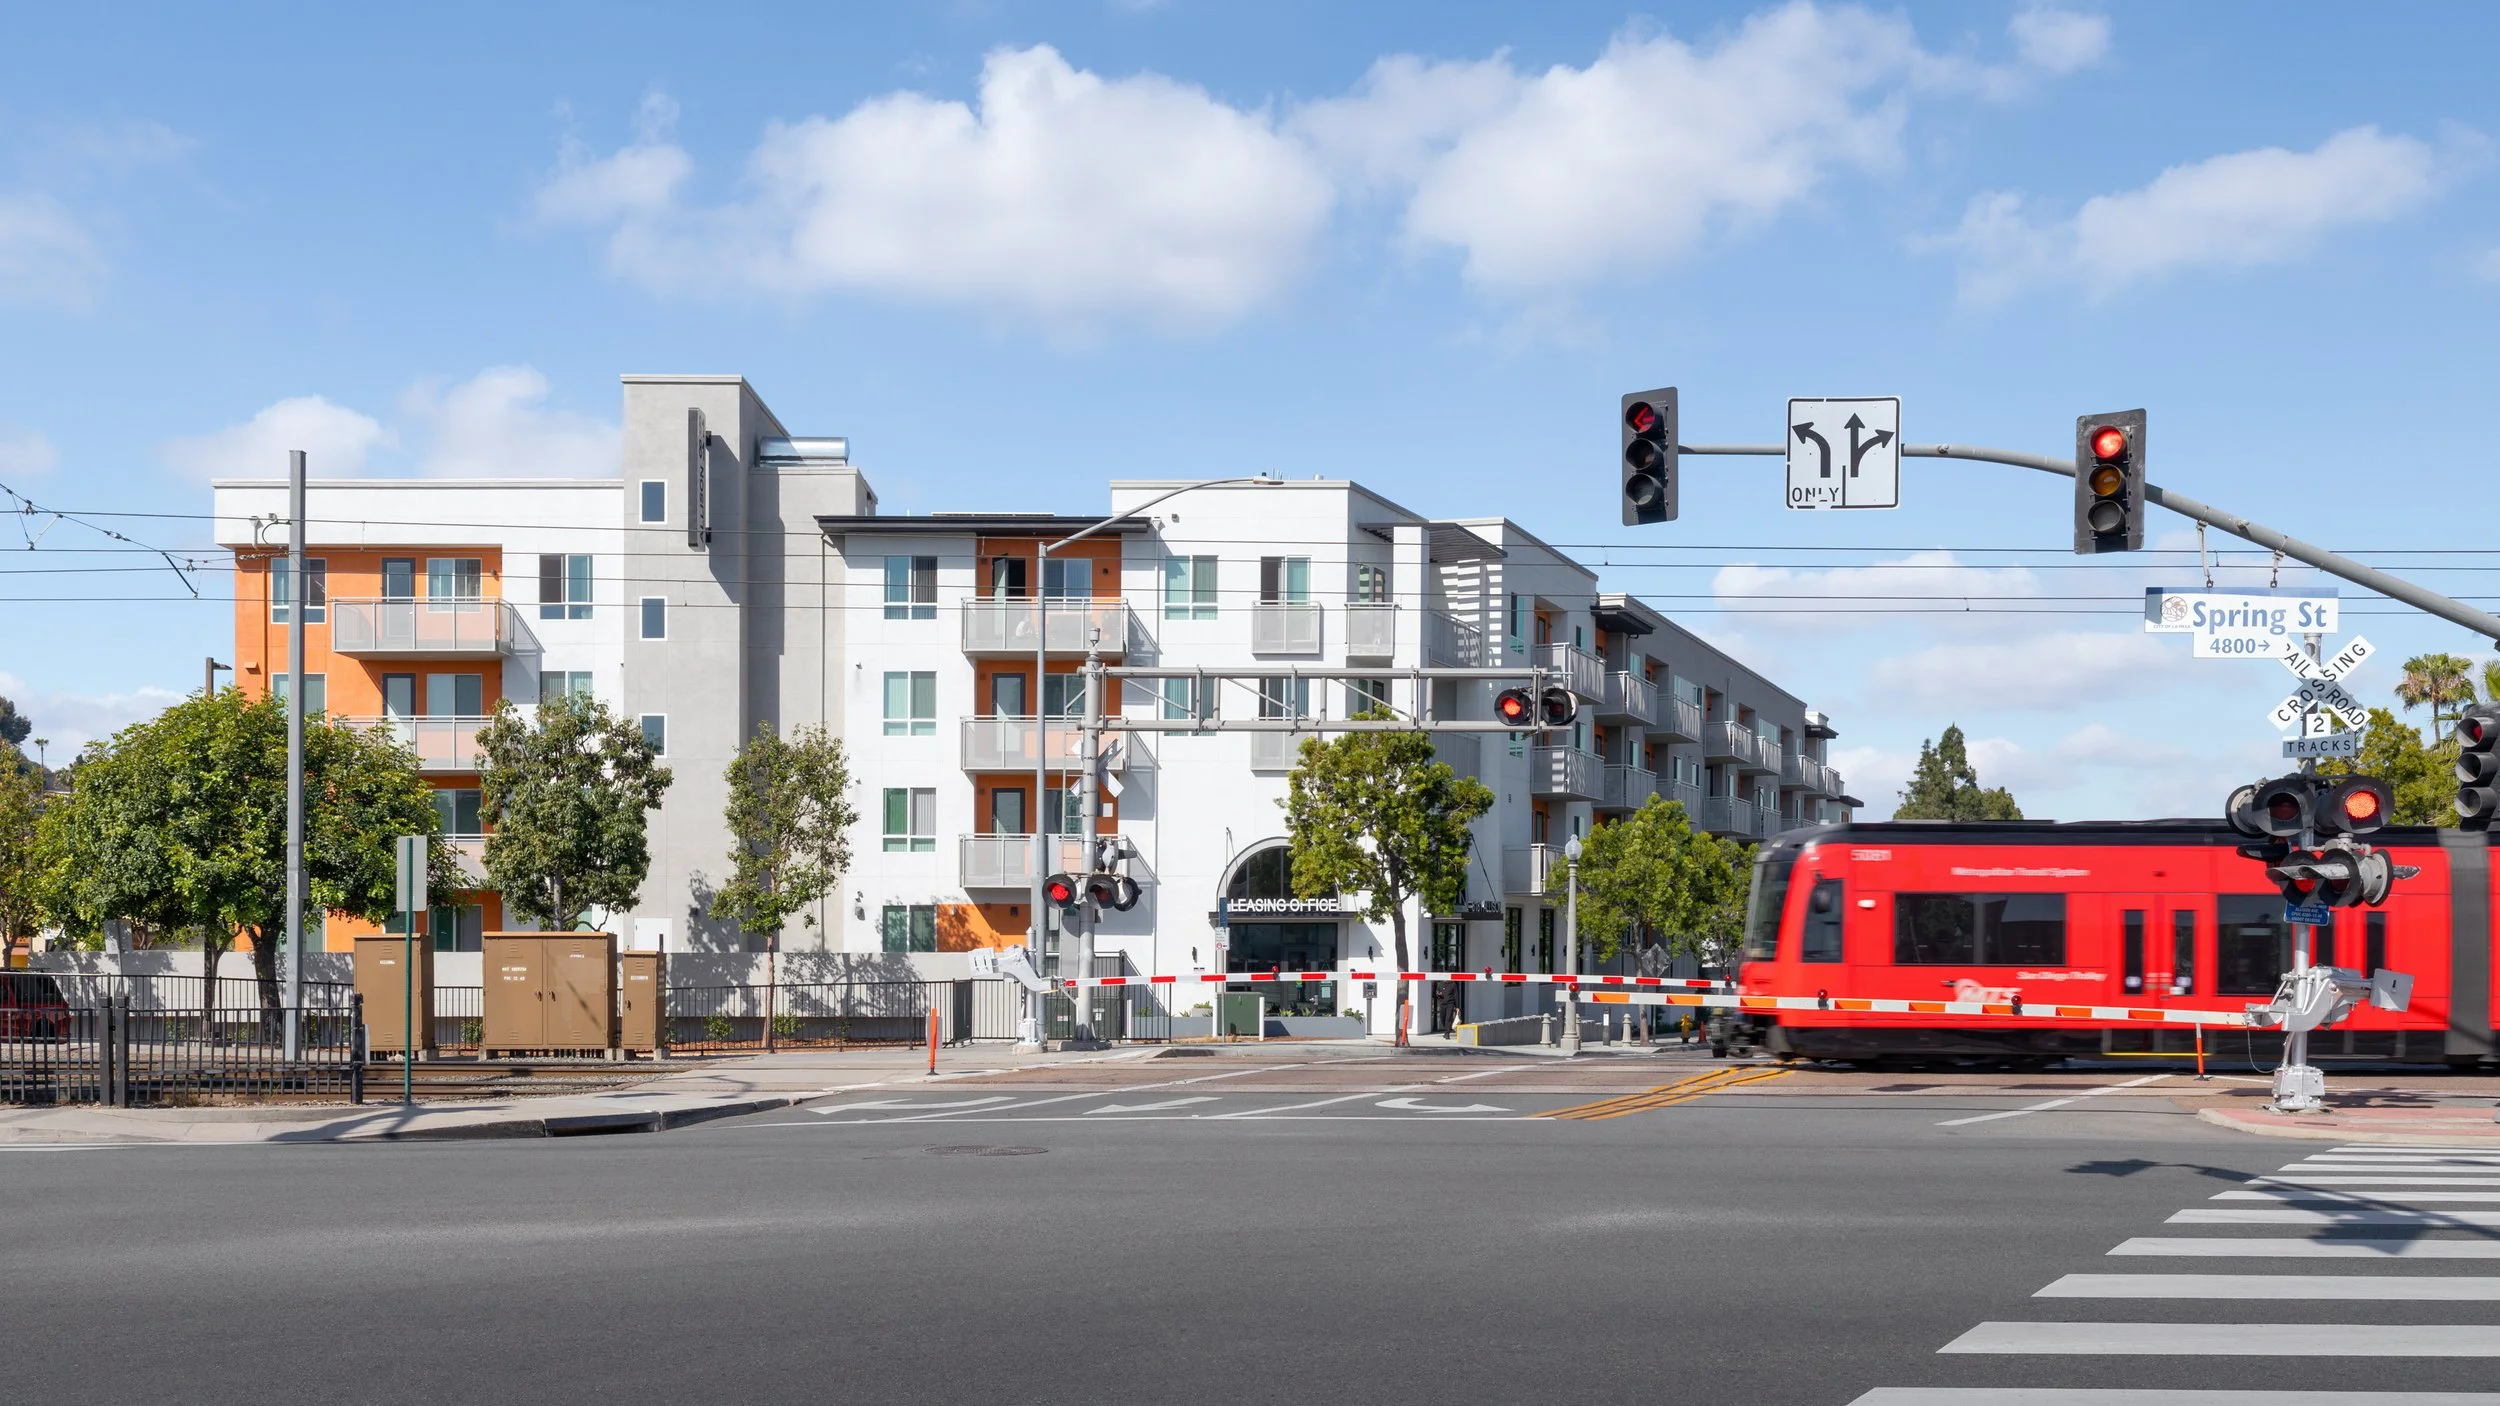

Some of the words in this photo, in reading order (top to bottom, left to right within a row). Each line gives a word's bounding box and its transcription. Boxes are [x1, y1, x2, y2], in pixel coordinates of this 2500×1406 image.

[1792, 487, 1839, 502] ONLY
[2193, 601, 2286, 635] Spring
[2298, 601, 2327, 627] St
[2209, 638, 2256, 653] 4800
[2277, 644, 2366, 722] CROSSING
[2313, 717, 2325, 732] 2
[2287, 740, 2351, 753] TRACKS
[1231, 898, 1286, 912] LEASING
